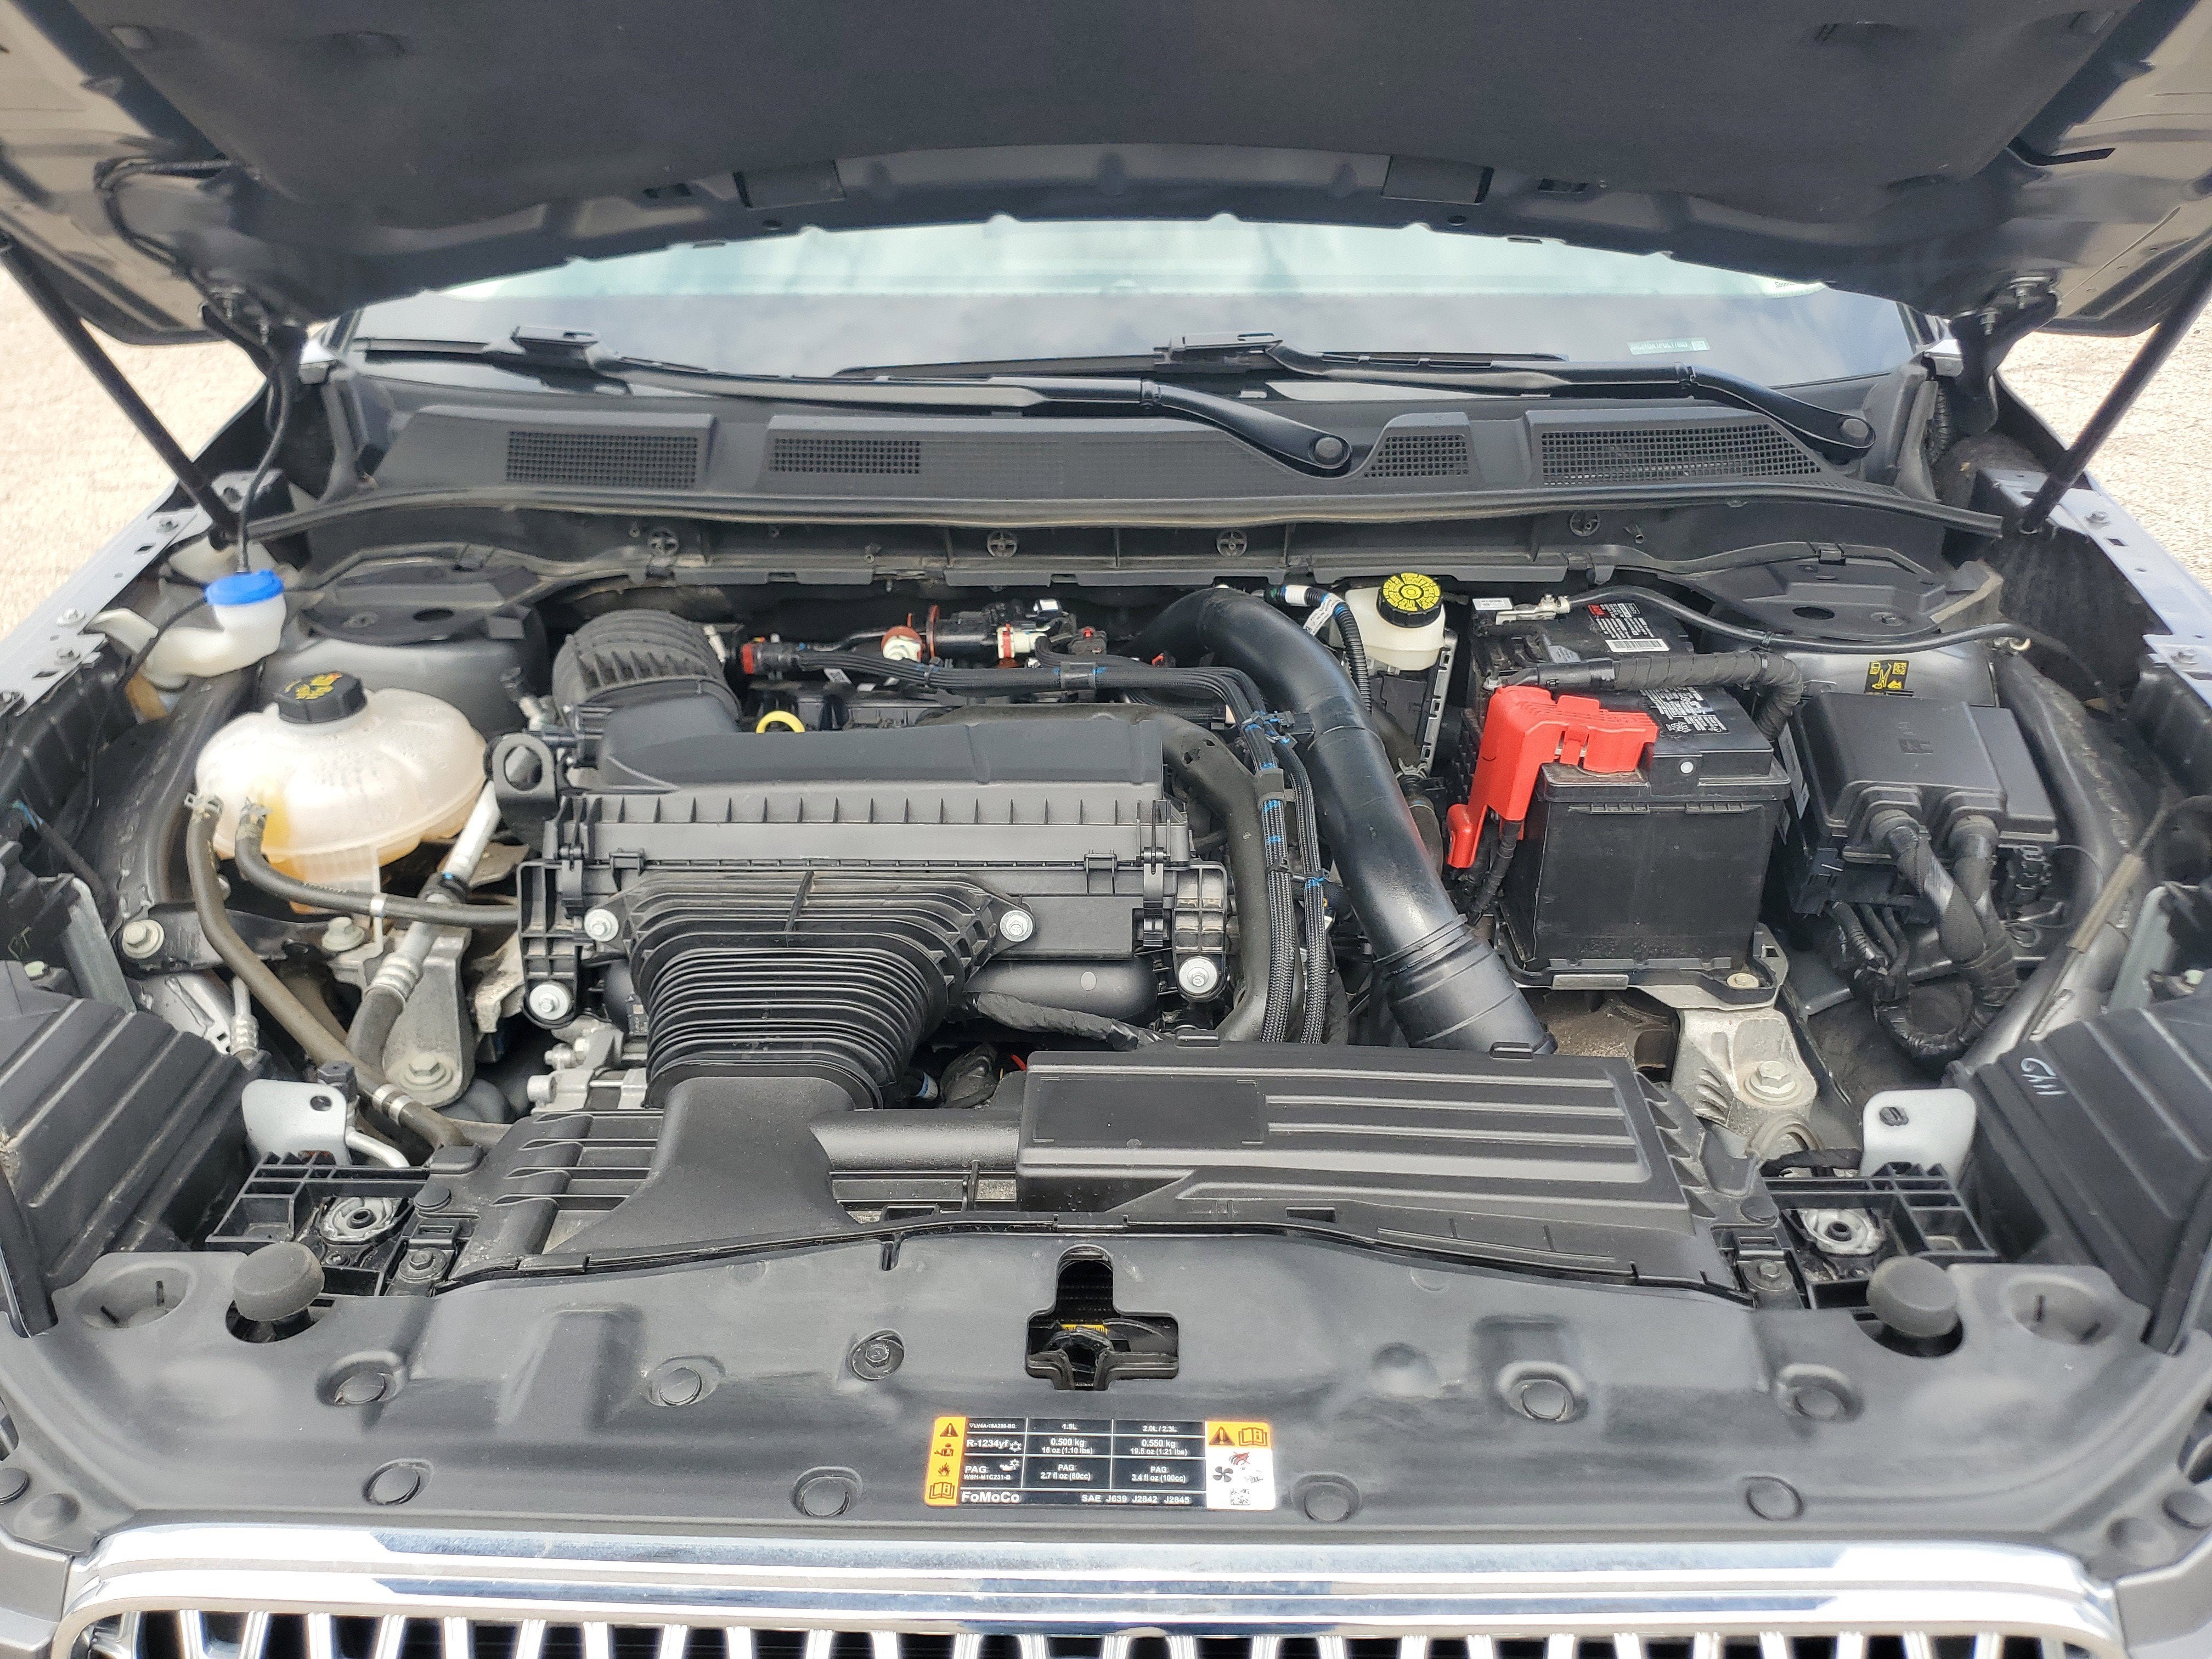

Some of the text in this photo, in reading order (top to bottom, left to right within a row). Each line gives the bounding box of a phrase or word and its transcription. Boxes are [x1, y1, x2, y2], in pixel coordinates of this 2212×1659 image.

[966, 1439, 1009, 1449] R-1234yf
[1051, 1437, 1085, 1447] 0.500 kg
[1142, 1439, 1176, 1448] 0.550 kg
[964, 1465, 987, 1474] PAG
[1160, 1474, 1186, 1483] (100cc)
[961, 1491, 1020, 1503] FoMoCo
[1132, 1495, 1158, 1503] J2842
